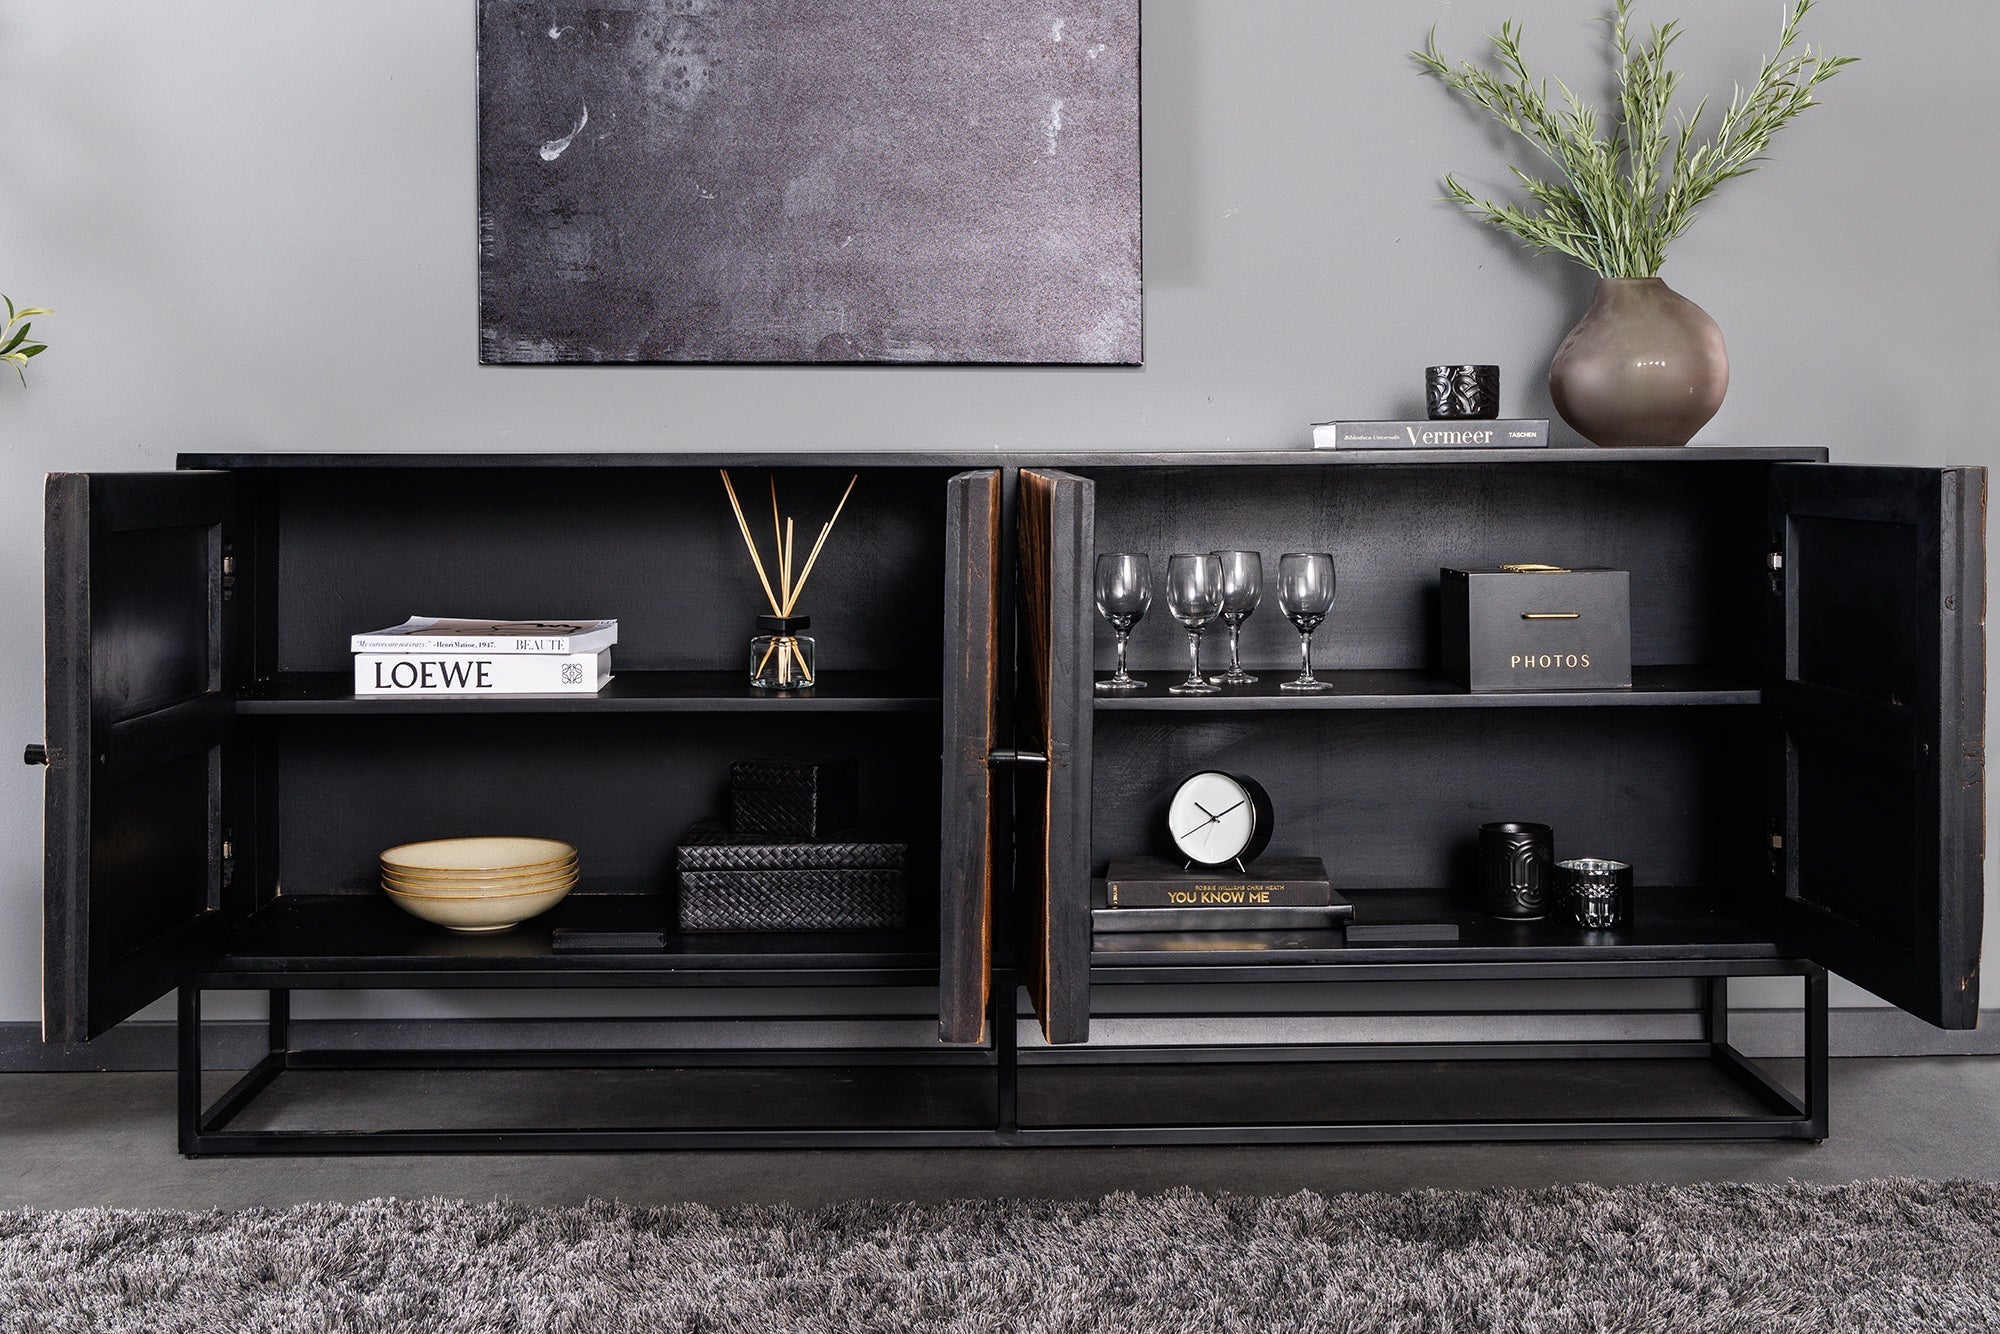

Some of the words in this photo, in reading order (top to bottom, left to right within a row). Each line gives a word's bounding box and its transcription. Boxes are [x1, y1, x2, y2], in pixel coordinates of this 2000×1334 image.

[1406, 426, 1494, 446] Vermeer
[1510, 654, 1591, 668] PHOTOS
[374, 661, 493, 689] LOEWE
[1167, 892, 1197, 904] YOU
[1201, 892, 1245, 904] KNOW
[1249, 892, 1270, 904] ME
